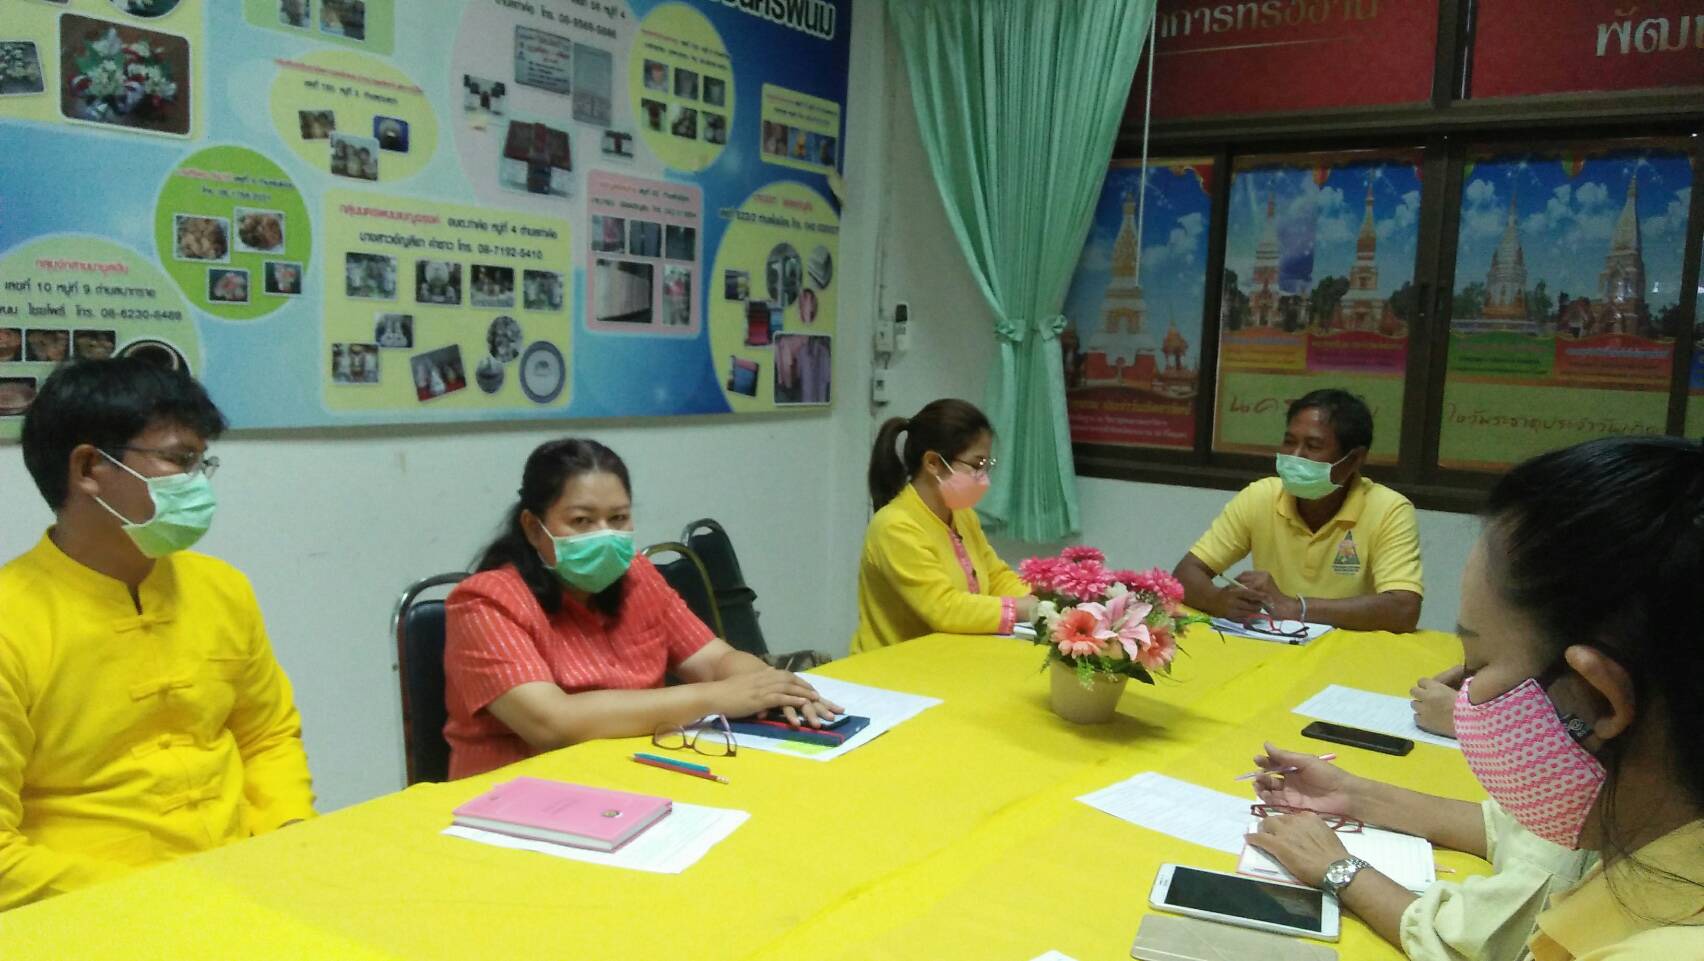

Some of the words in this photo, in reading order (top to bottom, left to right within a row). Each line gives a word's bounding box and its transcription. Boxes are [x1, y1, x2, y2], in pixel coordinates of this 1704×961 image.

[511, 225, 517, 233] 4
[38, 283, 52, 293] 10
[83, 284, 90, 294] 9
